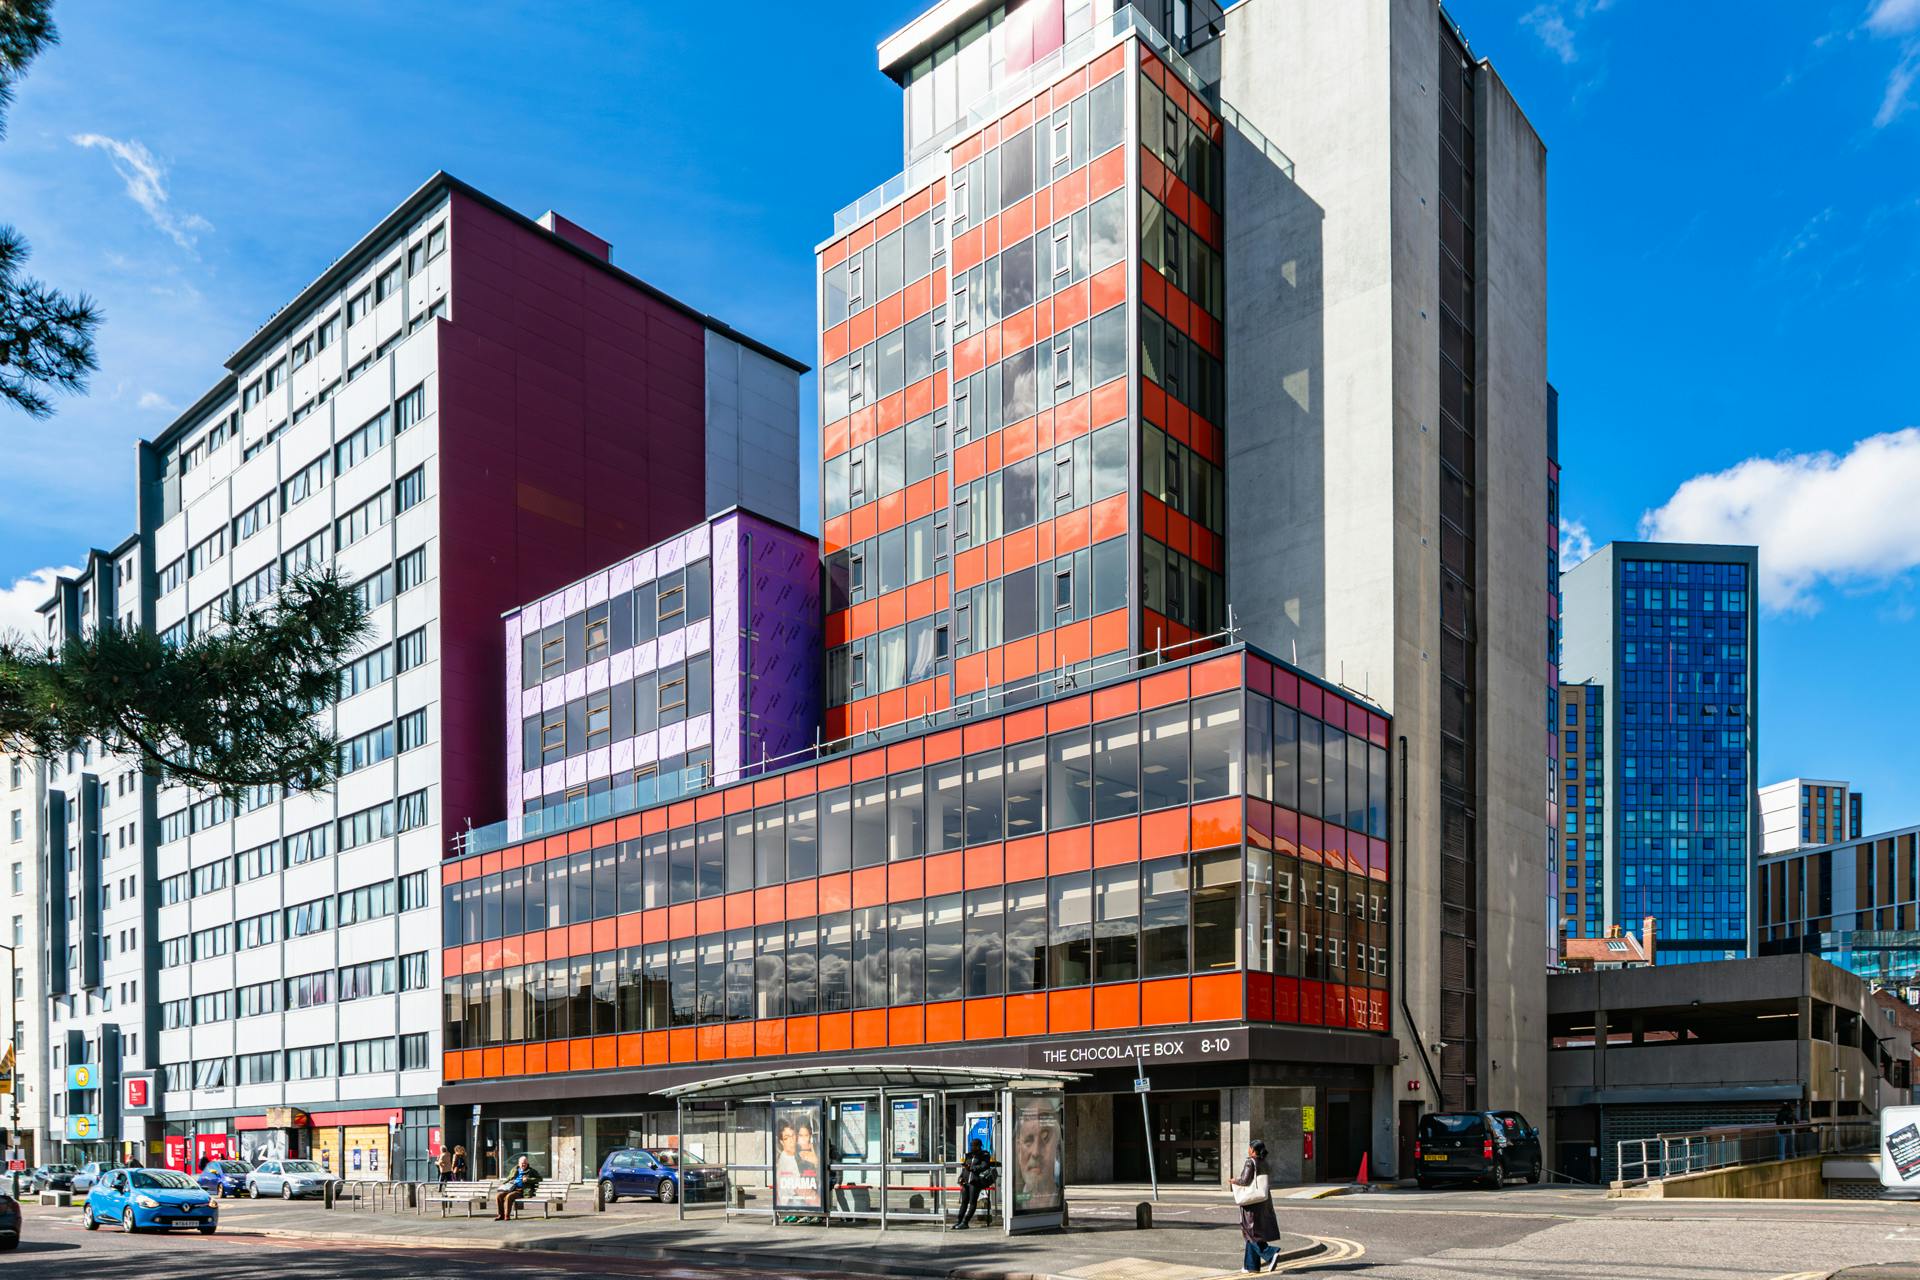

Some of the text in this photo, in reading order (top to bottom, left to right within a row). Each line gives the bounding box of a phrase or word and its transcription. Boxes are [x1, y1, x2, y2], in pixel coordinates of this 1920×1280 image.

[1043, 1038, 1230, 1063] THE CHOCOLATE BOX 8-10
[779, 1177, 817, 1190] DRAMA
